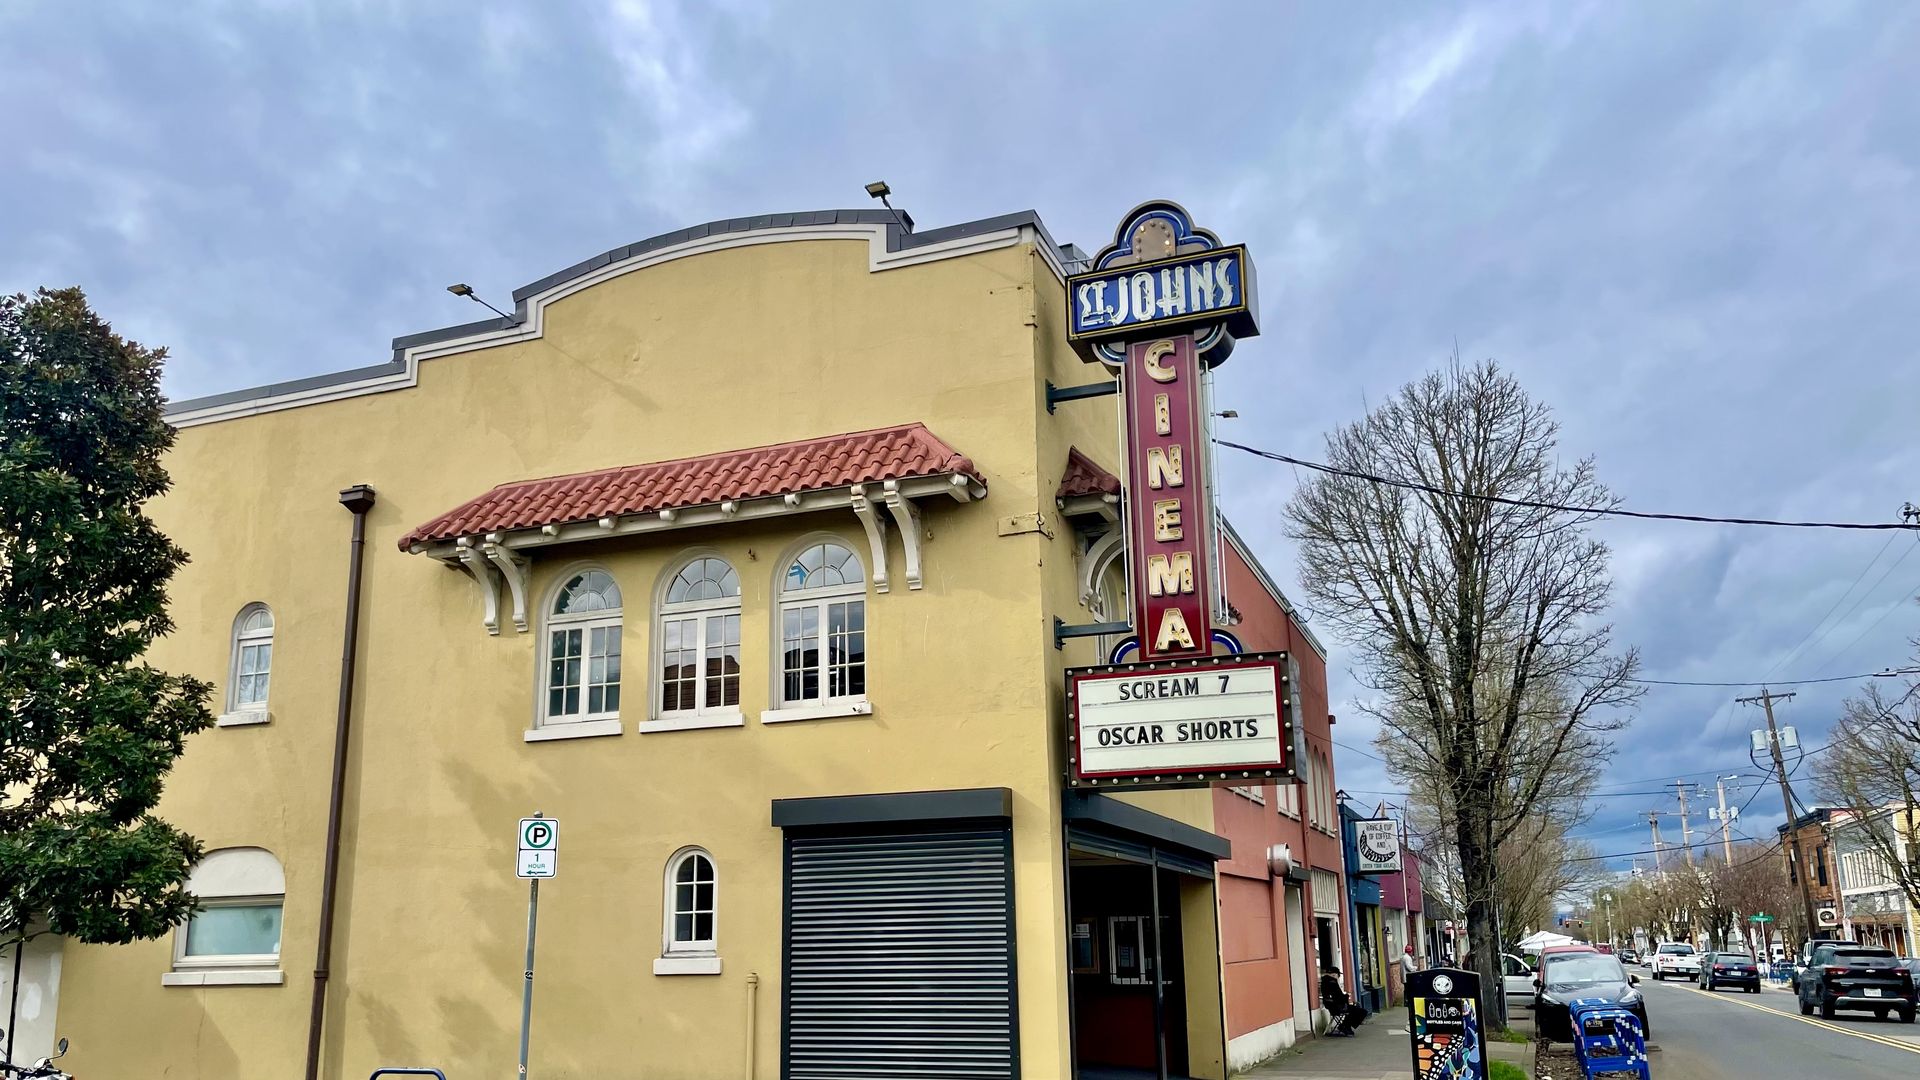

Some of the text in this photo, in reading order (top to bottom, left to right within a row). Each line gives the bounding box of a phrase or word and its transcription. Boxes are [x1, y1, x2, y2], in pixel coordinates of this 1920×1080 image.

[1107, 258, 1234, 326] JOHNS
[1143, 339, 1196, 651] CINEMA
[1118, 674, 1230, 701] SCREAM 7
[1097, 718, 1259, 747] OSCAR SHORTS
[533, 827, 547, 843] P
[1376, 841, 1386, 849] AND
[534, 853, 540, 862] 1
